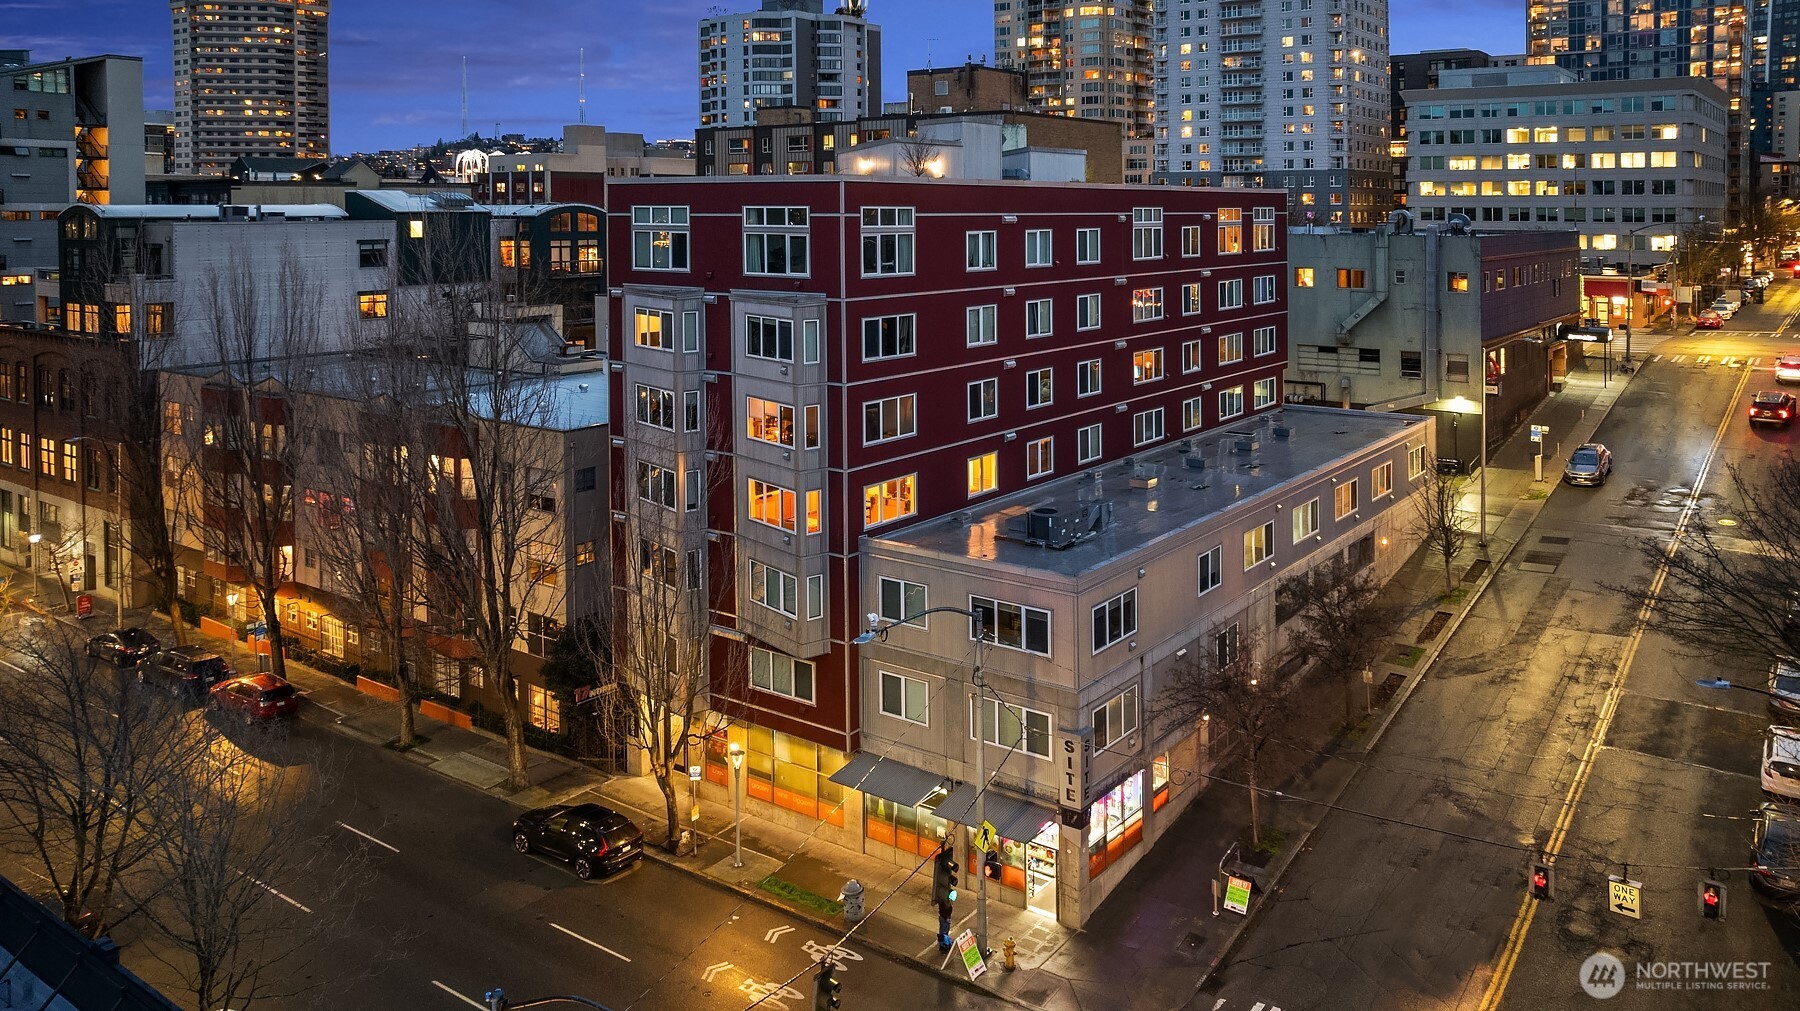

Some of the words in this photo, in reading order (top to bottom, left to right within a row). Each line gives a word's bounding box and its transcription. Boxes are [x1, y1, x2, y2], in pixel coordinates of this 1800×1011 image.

[1064, 740, 1076, 802] SITE
[1613, 884, 1635, 896] ONE
[1613, 892, 1636, 905] WAY
